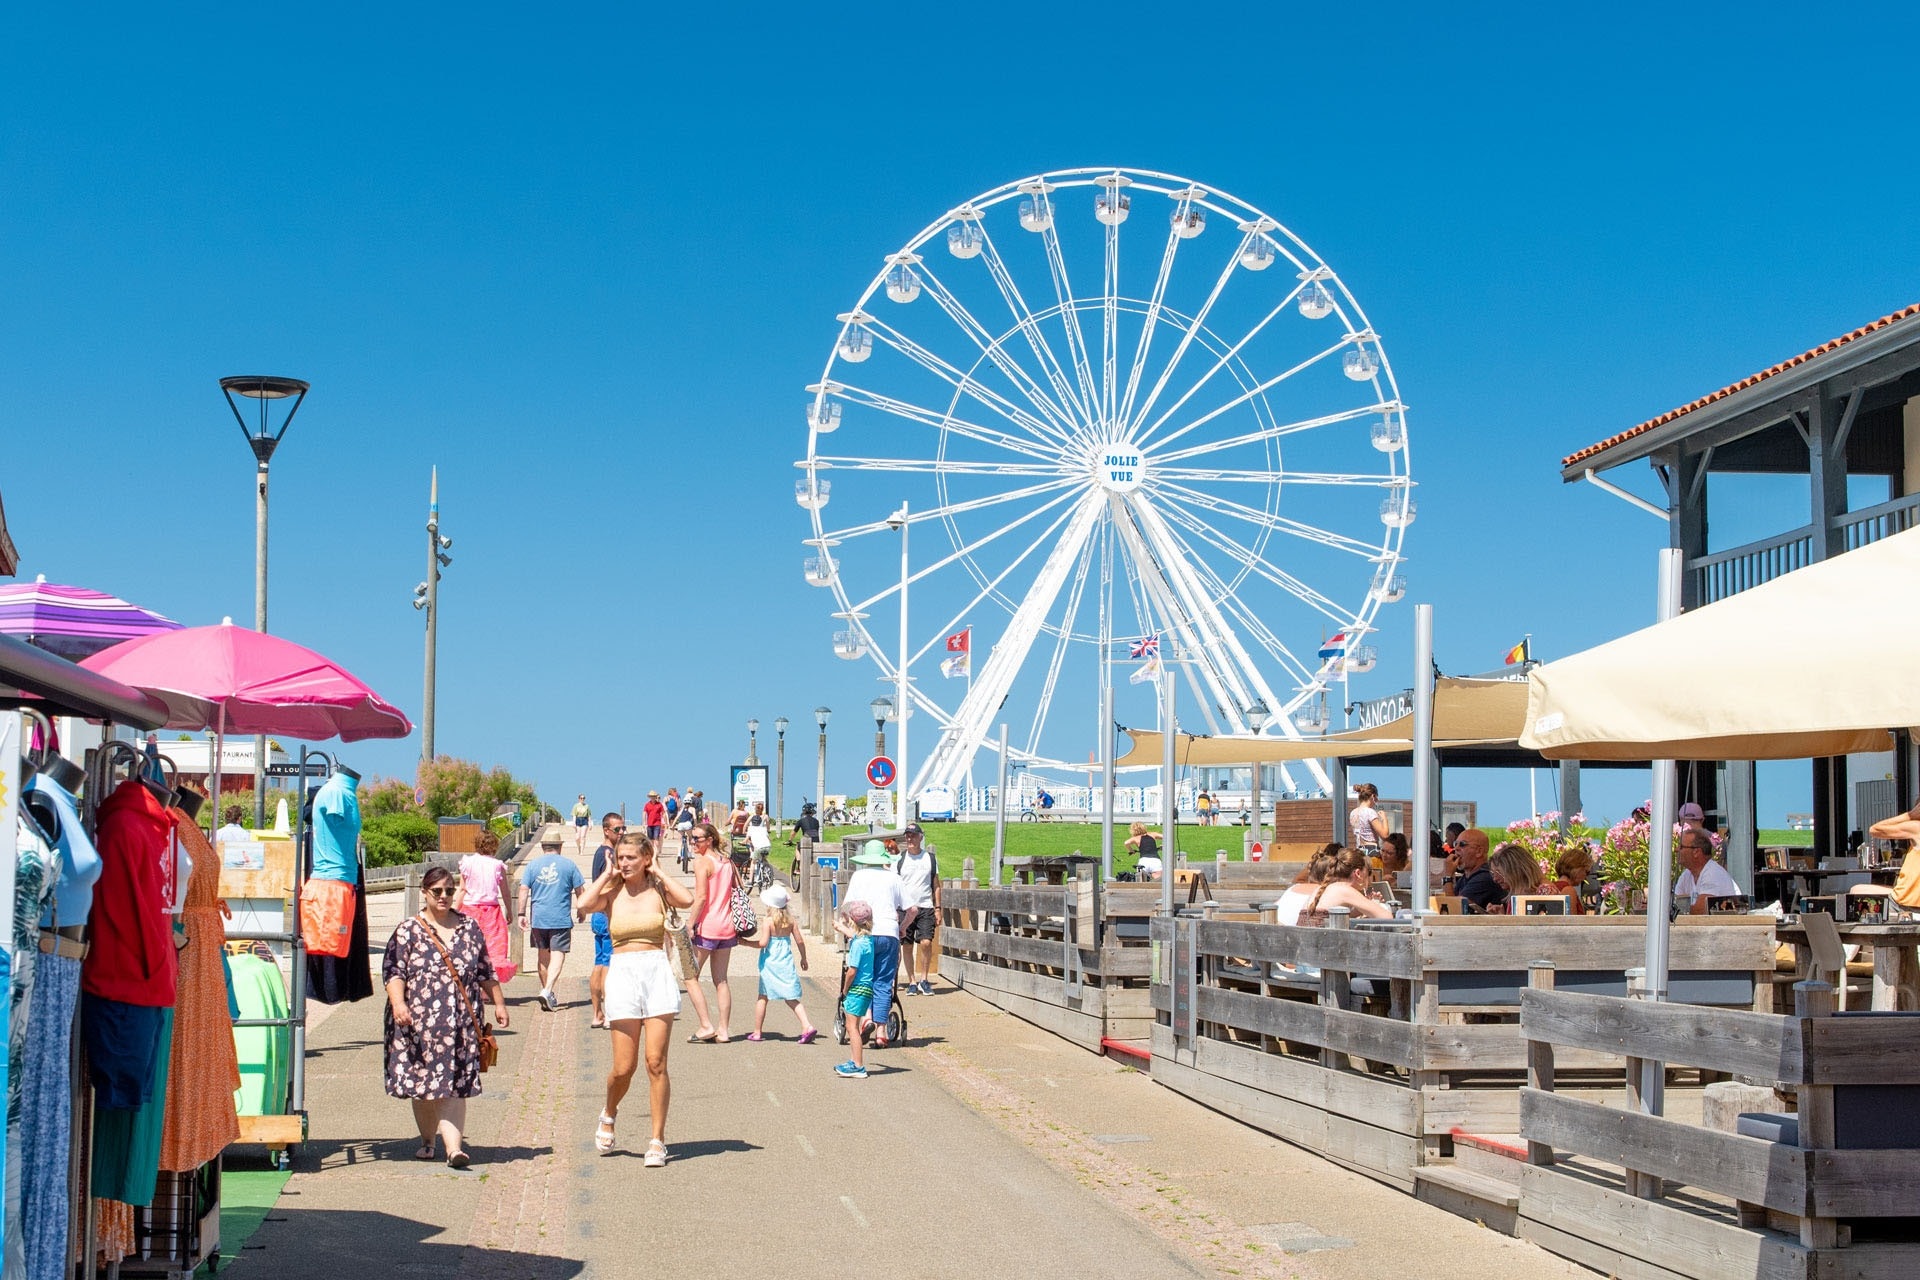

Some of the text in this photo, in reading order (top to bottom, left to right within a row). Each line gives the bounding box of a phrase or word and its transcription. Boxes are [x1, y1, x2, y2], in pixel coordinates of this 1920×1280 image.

[1104, 455, 1138, 466] JOLIE
[1111, 471, 1133, 482] VUE
[1359, 699, 1396, 731] SANGO
